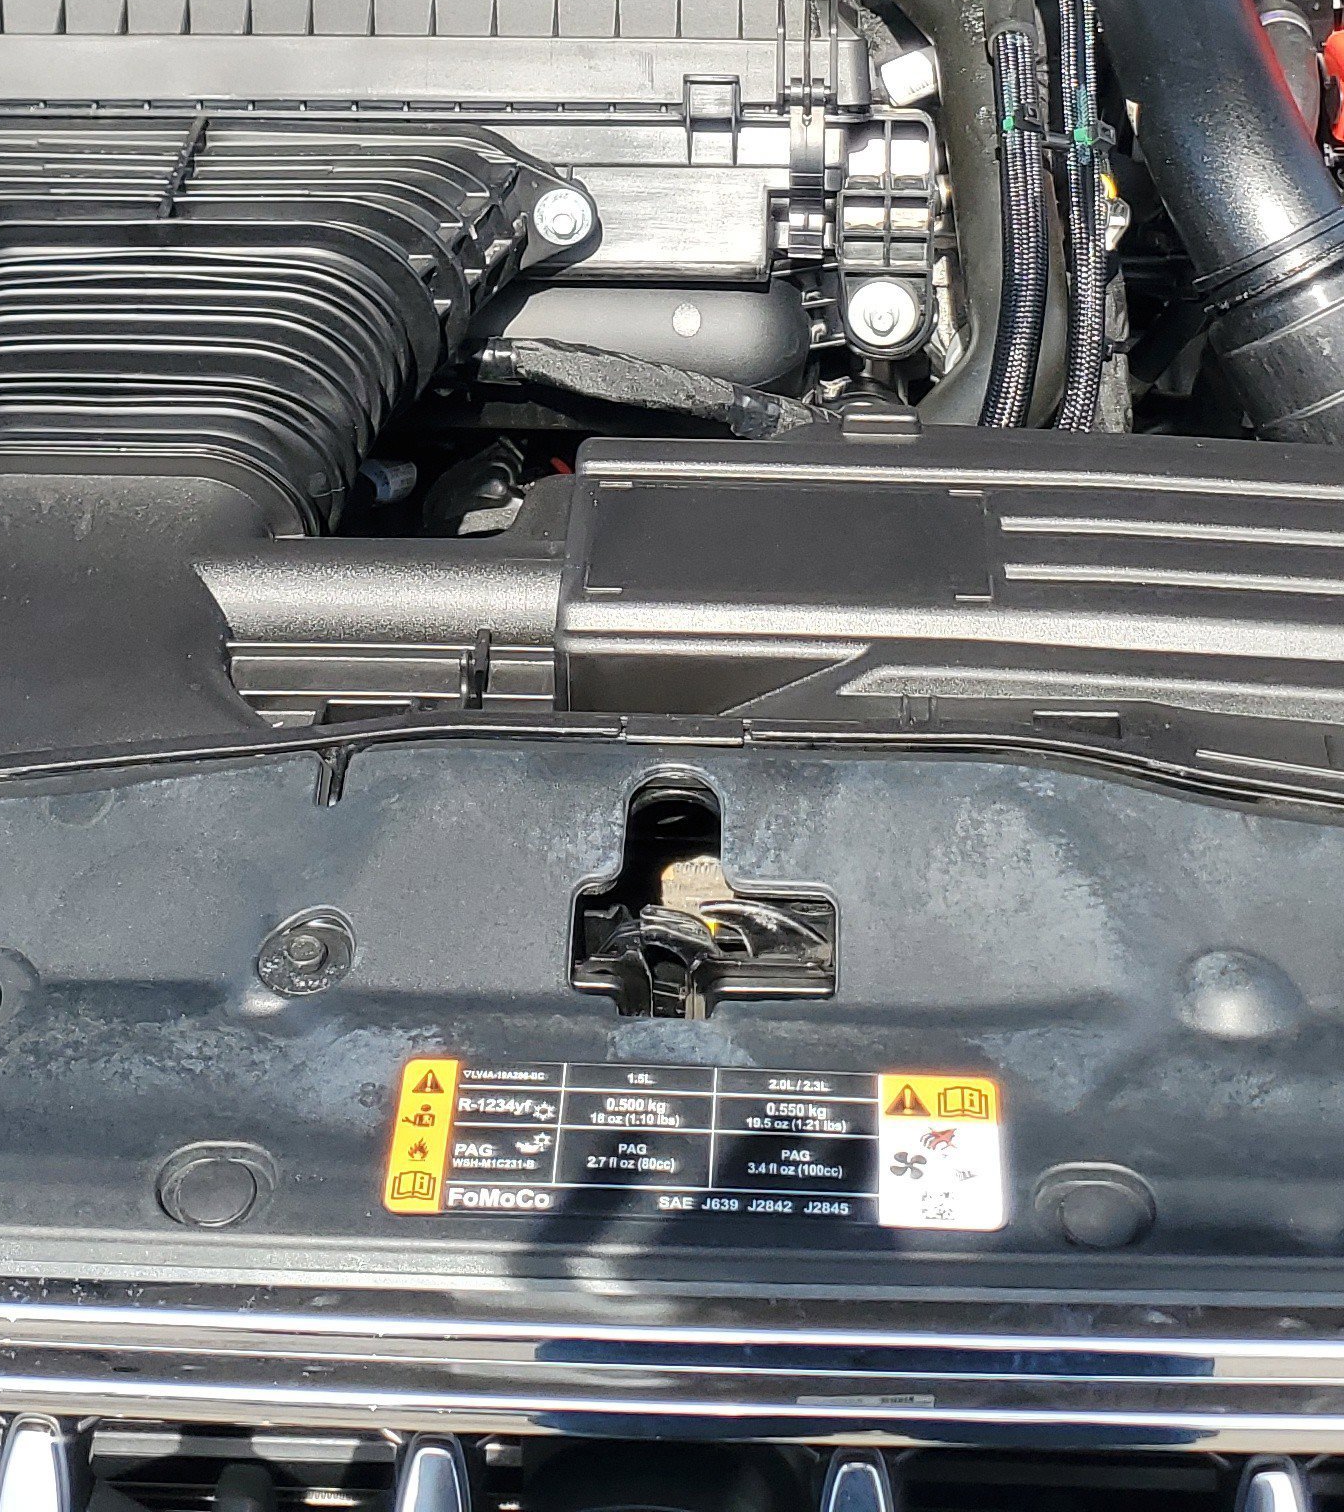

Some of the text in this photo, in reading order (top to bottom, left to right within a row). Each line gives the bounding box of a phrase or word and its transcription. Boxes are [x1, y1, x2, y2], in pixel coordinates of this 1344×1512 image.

[626, 1072, 656, 1085] 1.5L
[768, 1078, 796, 1090] 2.0L
[458, 1096, 534, 1116] R-1234yf
[606, 1097, 667, 1115] 0.500 kg
[766, 1102, 828, 1120] 0.550 kg
[607, 1114, 624, 1125] oz
[625, 1112, 655, 1127] (1.10
[656, 1113, 681, 1128] lbs)
[746, 1117, 847, 1133] 19.5 oz (1.21 lbs)
[454, 1143, 495, 1158] PAG
[618, 1143, 648, 1155] PAG
[781, 1149, 811, 1162] PAG
[586, 1155, 676, 1174] 2.7 fl oz (80cc)
[747, 1162, 844, 1180] 3.4 fl oz (100cc)
[446, 1187, 552, 1209] FoMoCo
[658, 1196, 851, 1215] SAE J639 J2842 J2845
